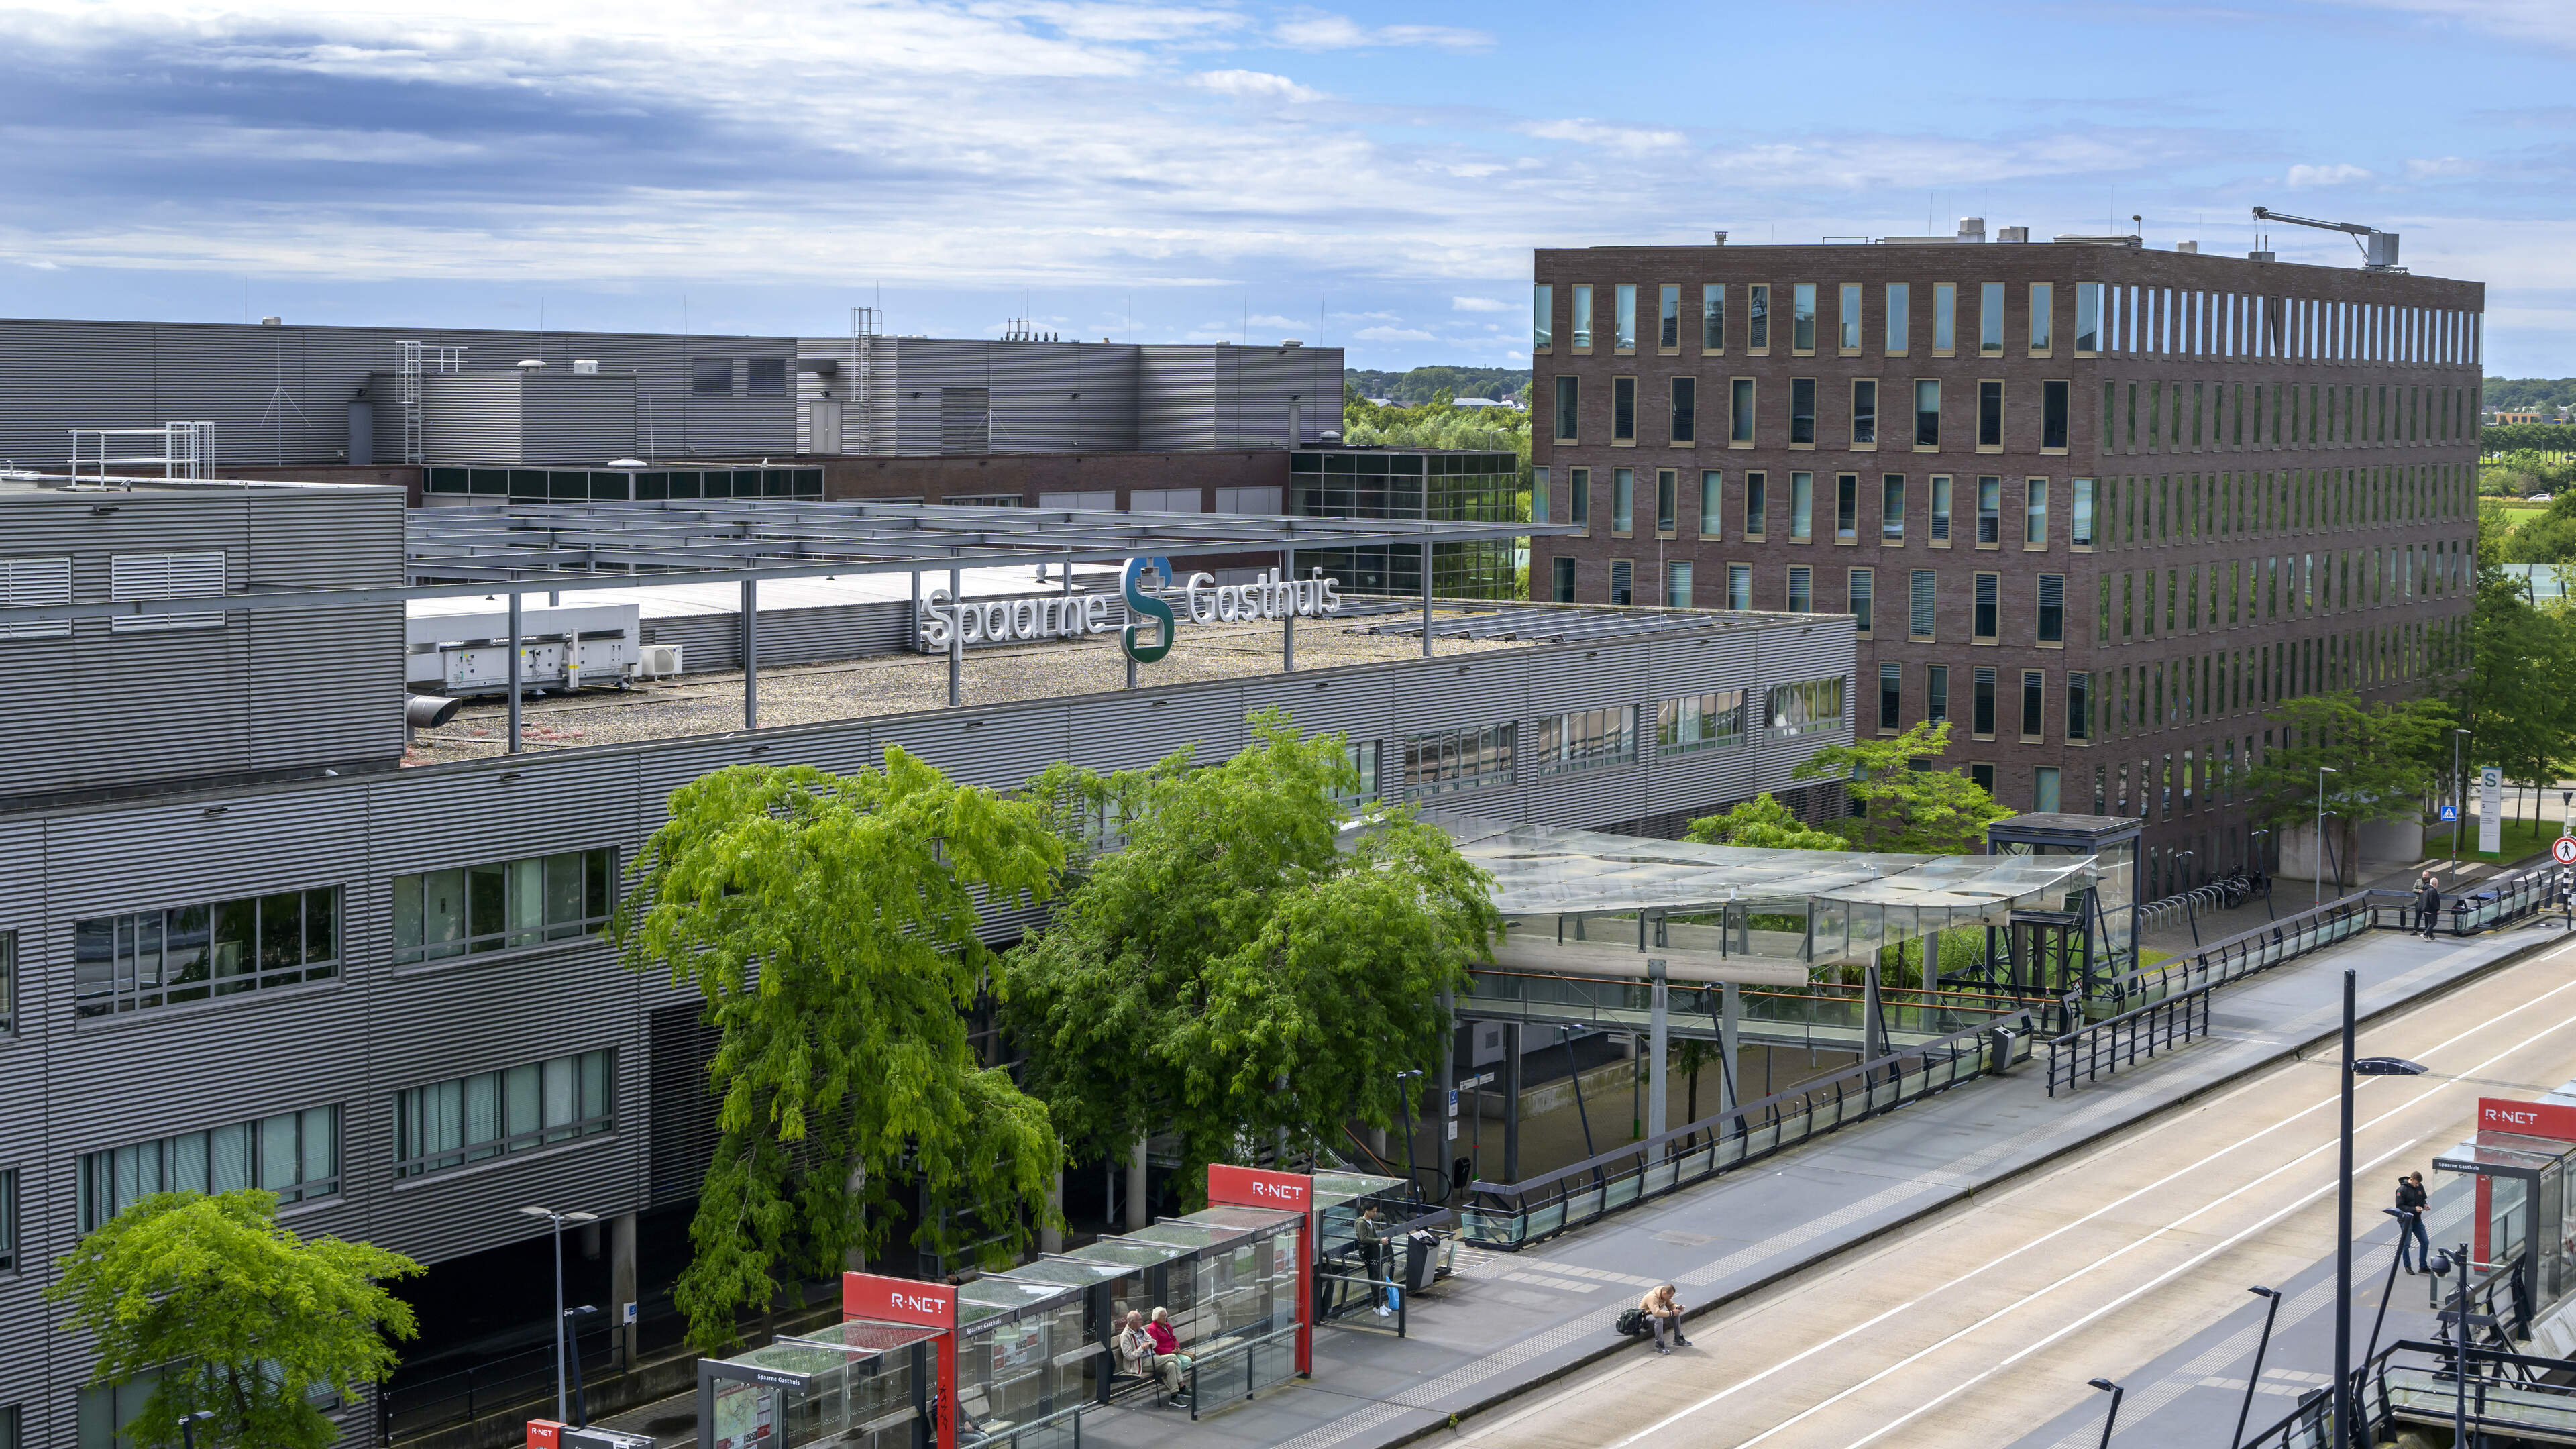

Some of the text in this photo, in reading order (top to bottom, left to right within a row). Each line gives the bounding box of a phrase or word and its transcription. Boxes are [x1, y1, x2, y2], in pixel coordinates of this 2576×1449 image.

[922, 588, 1108, 663] Spaarne
[1186, 566, 1341, 625] Gasthuis
[1267, 1222, 1295, 1236] Spaarne Gasthuis
[967, 1318, 1002, 1334] Spaarne Gasthuis
[757, 1373, 800, 1386] Spaarne Gasthuis
